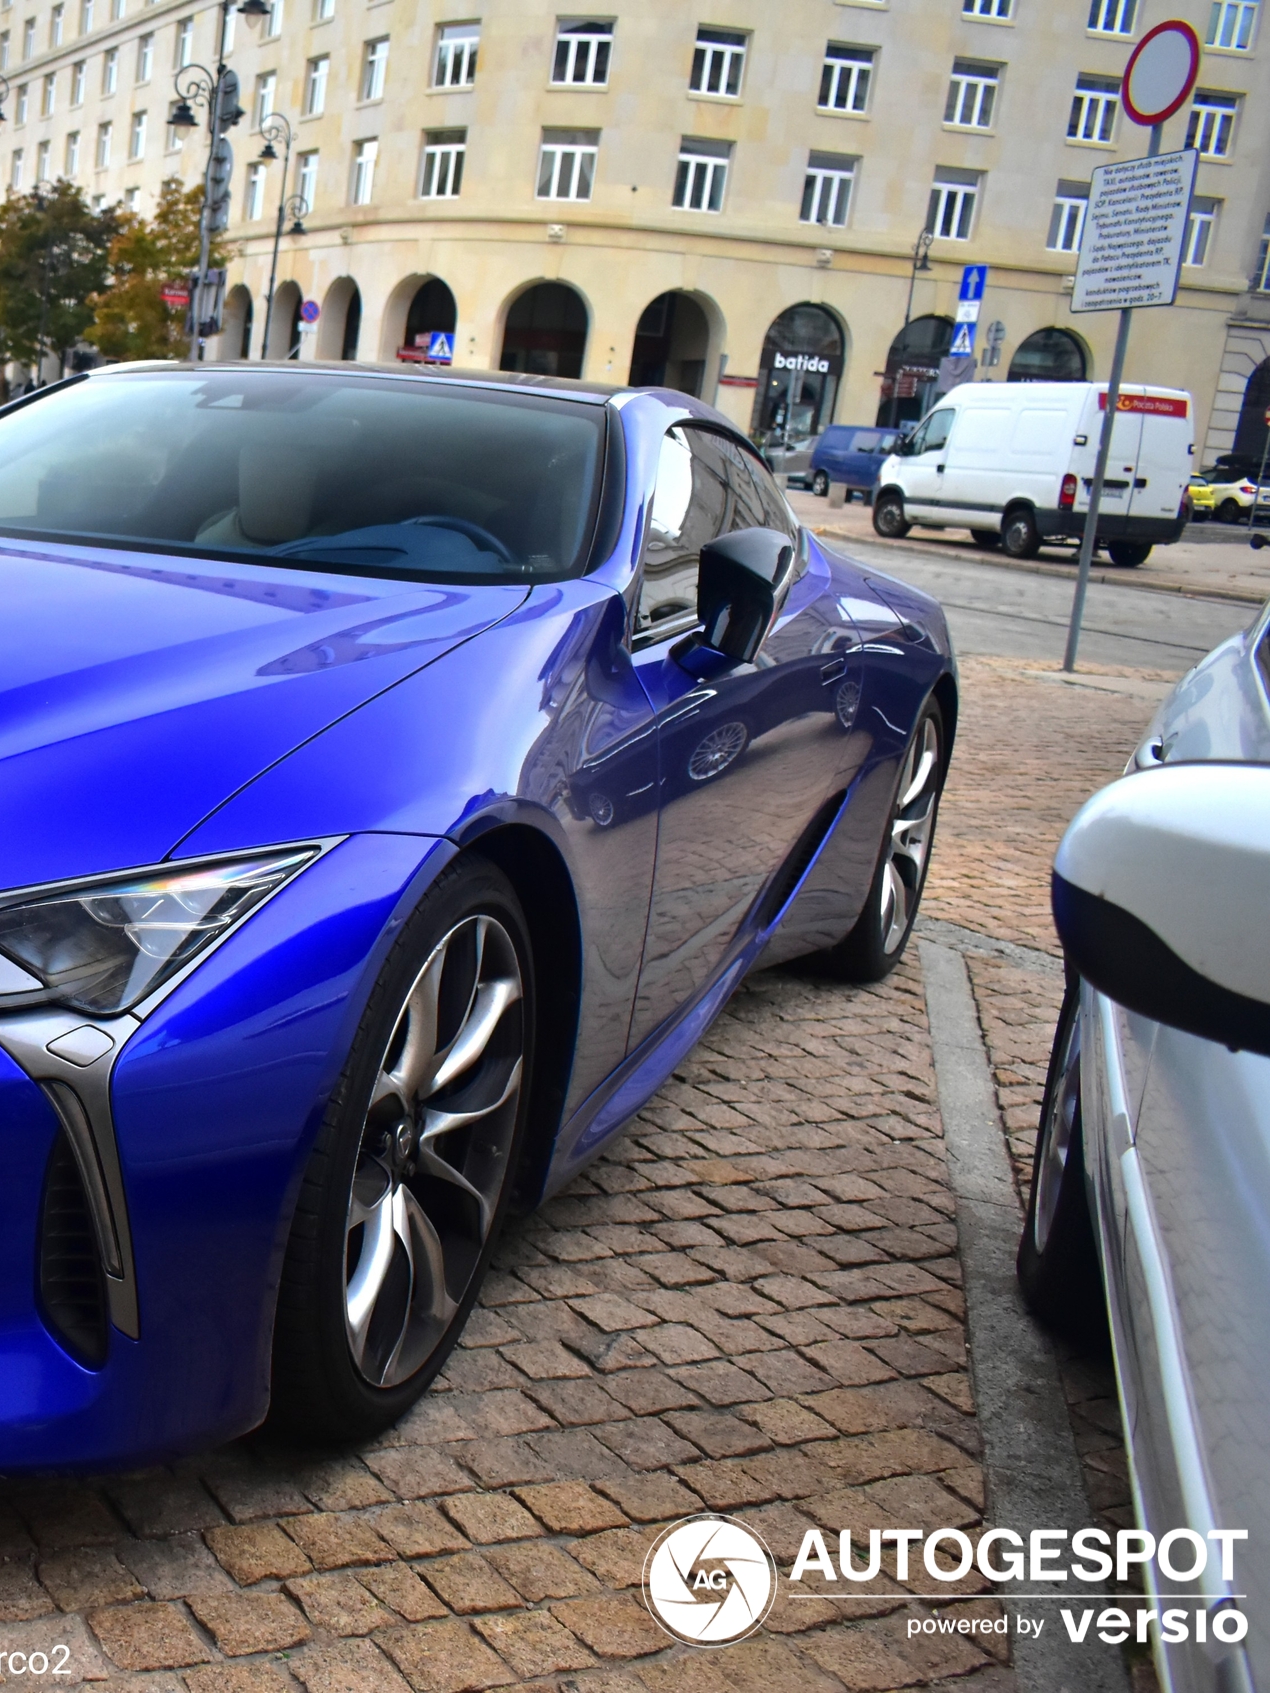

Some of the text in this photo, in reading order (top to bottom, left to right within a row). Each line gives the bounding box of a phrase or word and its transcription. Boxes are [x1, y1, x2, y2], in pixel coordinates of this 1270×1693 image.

[1104, 167, 1113, 175] Nie
[1114, 164, 1135, 174] dotyczy
[1140, 189, 1173, 201] Prezydenta
[1135, 204, 1150, 214] Rady
[1121, 249, 1153, 260] Prezydenta
[774, 351, 829, 373] batida
[1133, 400, 1173, 411] Poczta Polska
